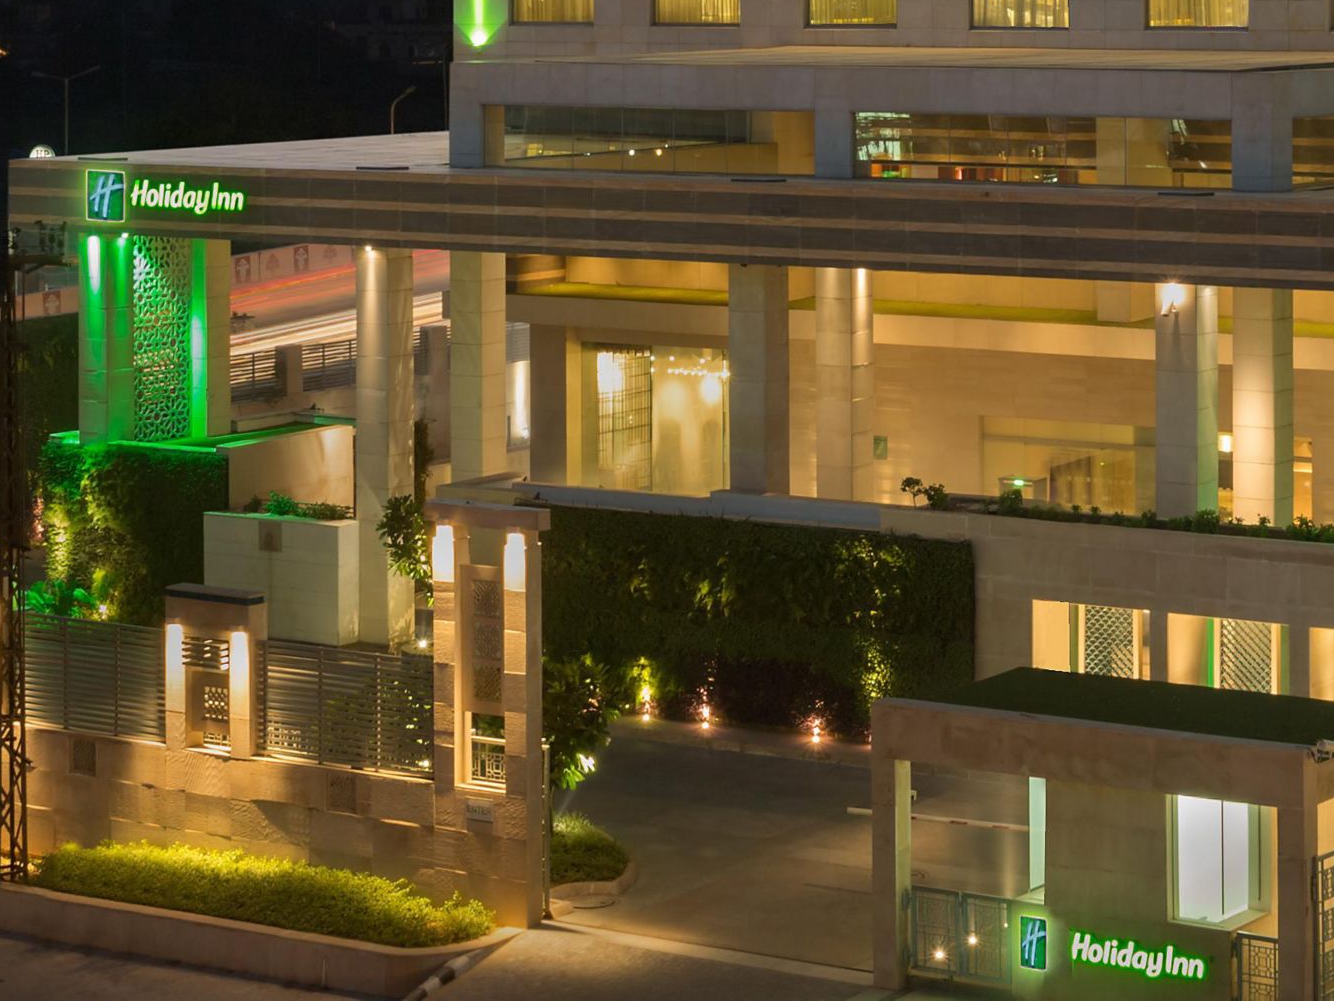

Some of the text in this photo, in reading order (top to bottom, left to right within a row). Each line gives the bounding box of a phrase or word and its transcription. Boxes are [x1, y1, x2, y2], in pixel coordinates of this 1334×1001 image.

[130, 179, 210, 215] Holiday
[211, 182, 245, 212] Inn
[1071, 932, 1164, 978] Holiday
[1165, 945, 1205, 979] Inn
